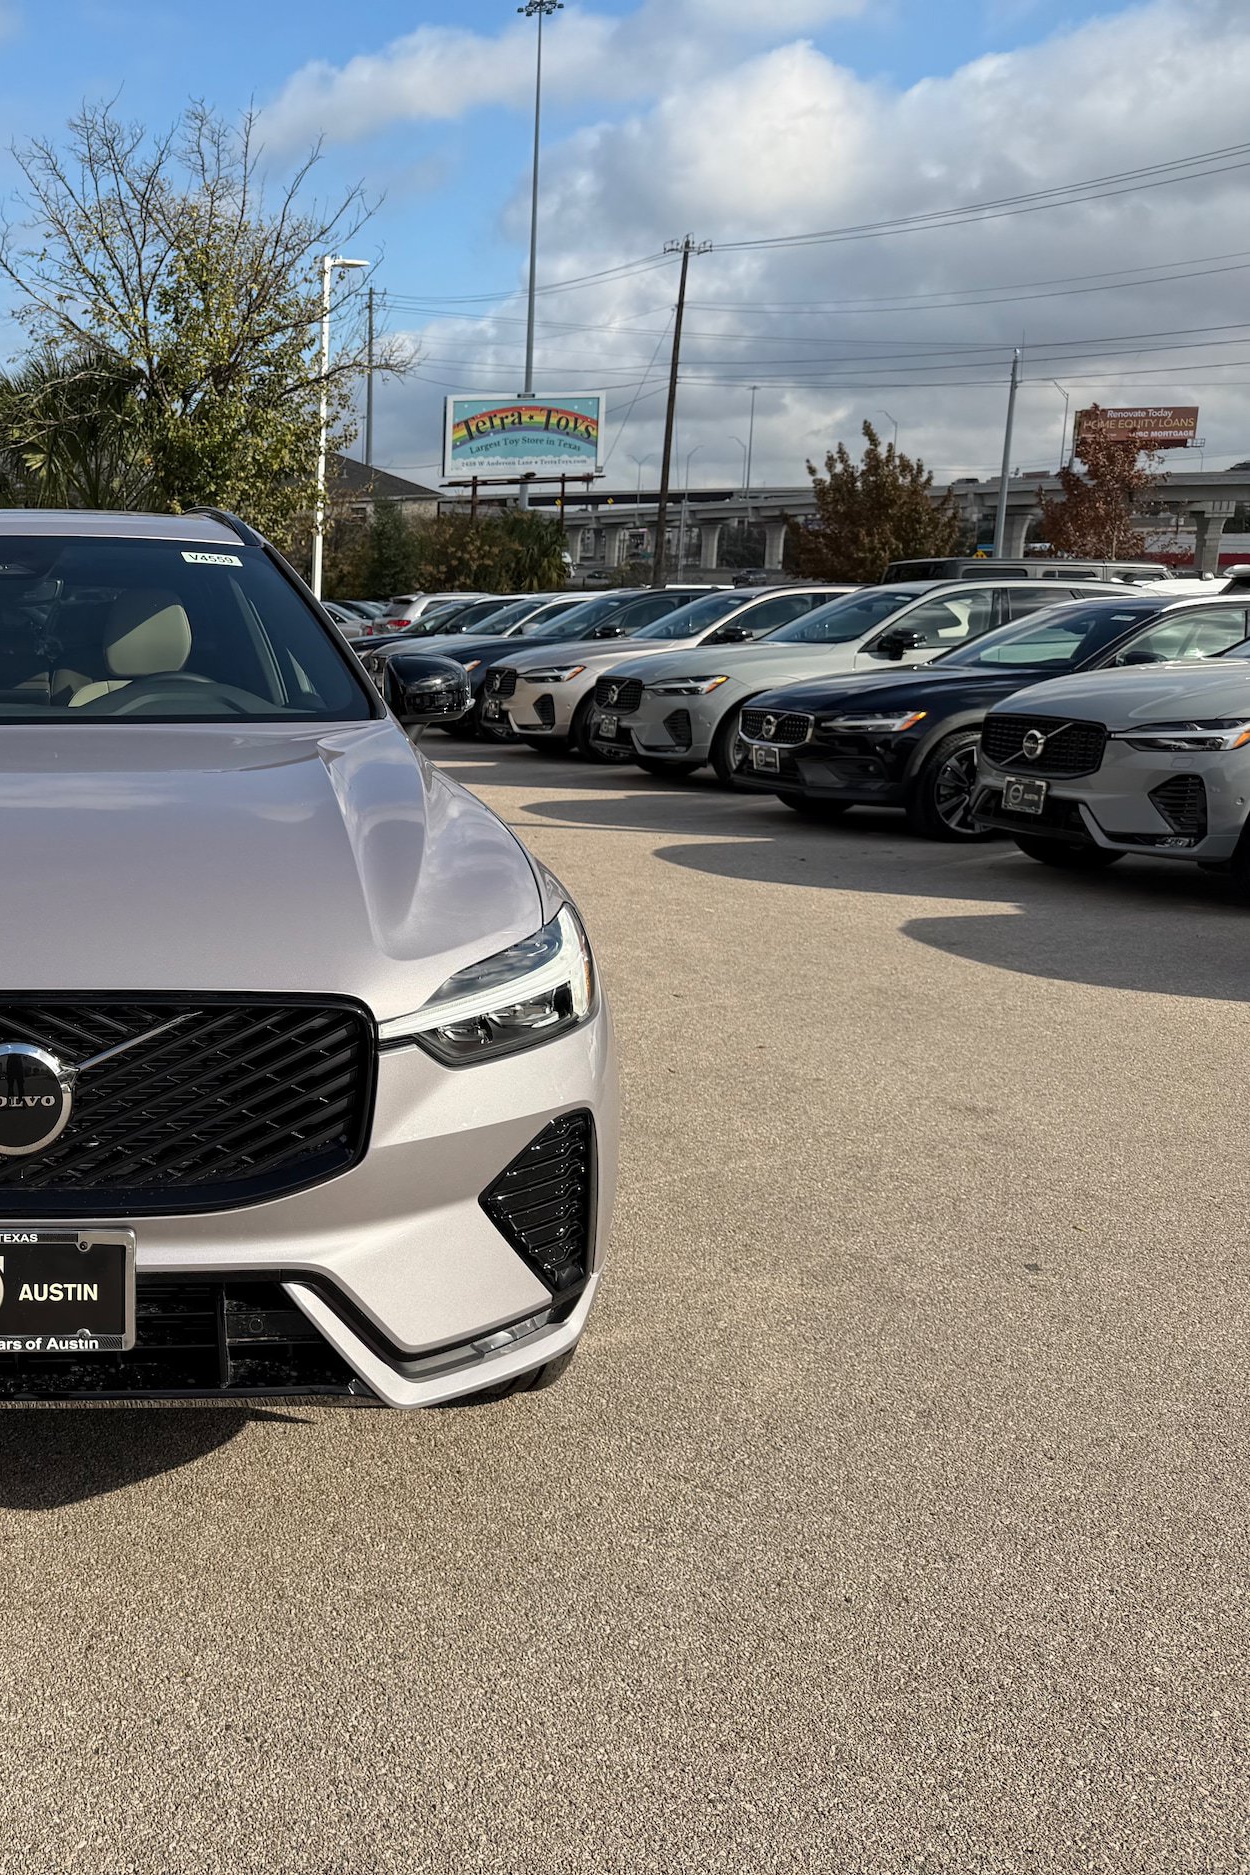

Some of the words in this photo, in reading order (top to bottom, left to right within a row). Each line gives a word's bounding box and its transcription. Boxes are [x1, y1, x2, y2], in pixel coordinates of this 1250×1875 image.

[1107, 410, 1146, 418] Renovate
[1148, 408, 1173, 419] Today
[457, 410, 523, 440] Terra
[540, 408, 595, 440] Toys
[1083, 419, 1115, 429] HOME
[1118, 418, 1157, 429] EQUITY
[1159, 417, 1195, 428] LOANS
[1150, 430, 1194, 438] MORTGAGE
[469, 441, 500, 455] Largest
[503, 438, 520, 447] Toy
[521, 436, 544, 445] Store
[546, 437, 555, 445] in
[556, 438, 581, 452] Texas
[188, 553, 233, 563] V4559
[18, 1283, 98, 1302] AUSTIN
[25, 1337, 43, 1350] of
[47, 1337, 99, 1350] Austin
